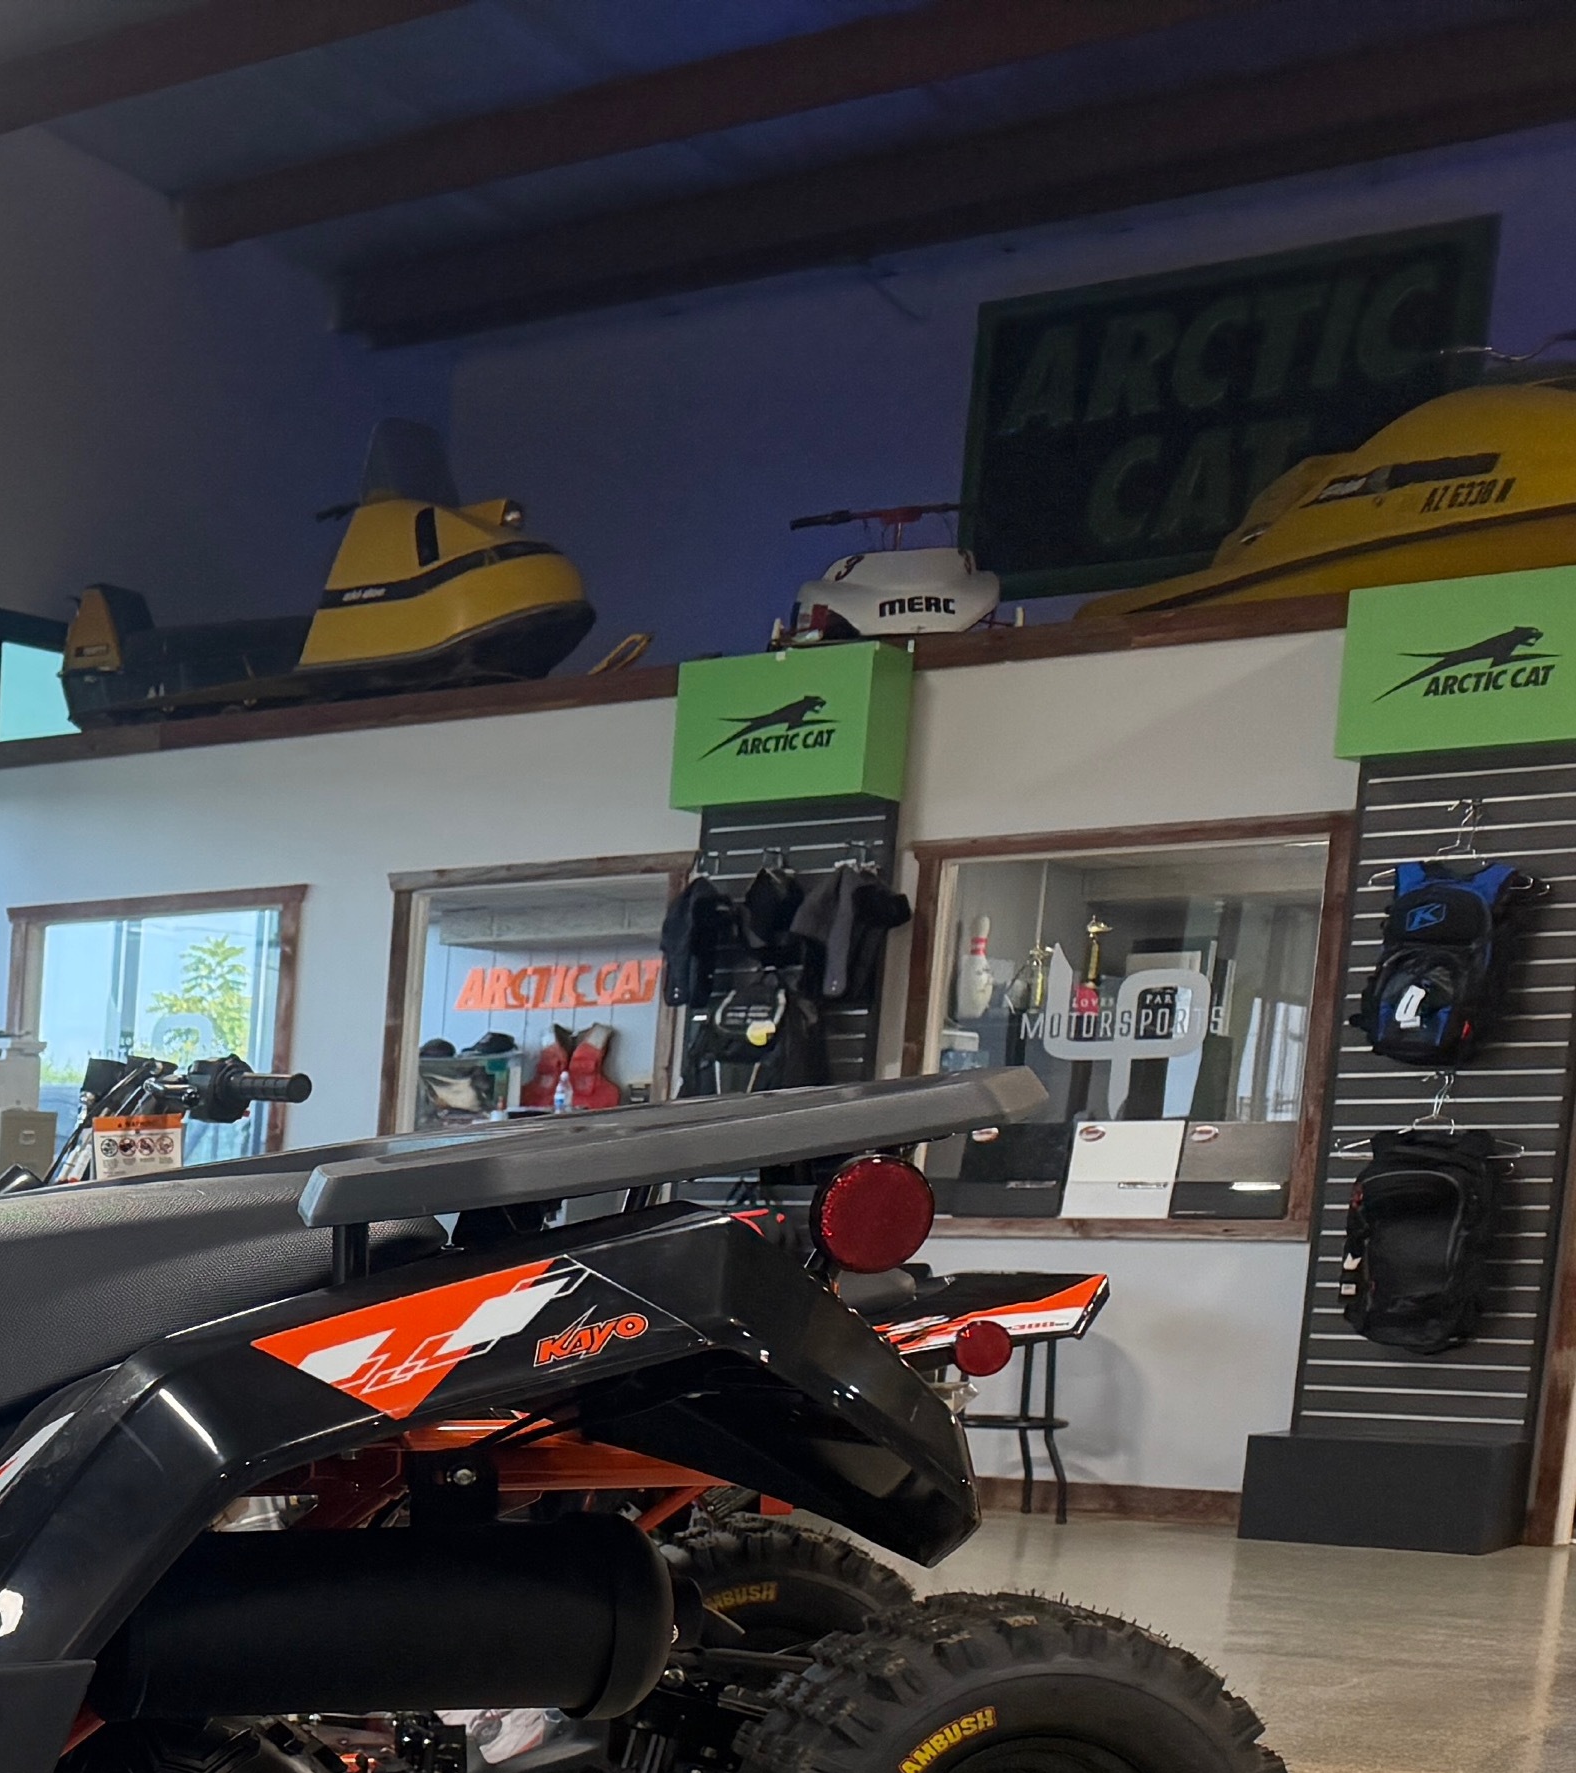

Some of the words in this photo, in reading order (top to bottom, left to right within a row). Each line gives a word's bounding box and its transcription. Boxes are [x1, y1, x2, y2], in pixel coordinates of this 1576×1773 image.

[999, 264, 1439, 438] ARCTIC
[1088, 415, 1315, 546] CAT
[878, 596, 956, 618] MERC
[1422, 669, 1508, 697] ARCTIC
[1510, 664, 1556, 688] CAT
[736, 733, 800, 756] ARCTIC
[802, 728, 836, 749] CAT
[454, 964, 593, 1010] ARCTIC
[594, 959, 663, 1006] CAT
[1146, 993, 1174, 1005] PAR
[1019, 1005, 1225, 1040] MOTORSPORTS
[534, 1308, 649, 1367] KAYO
